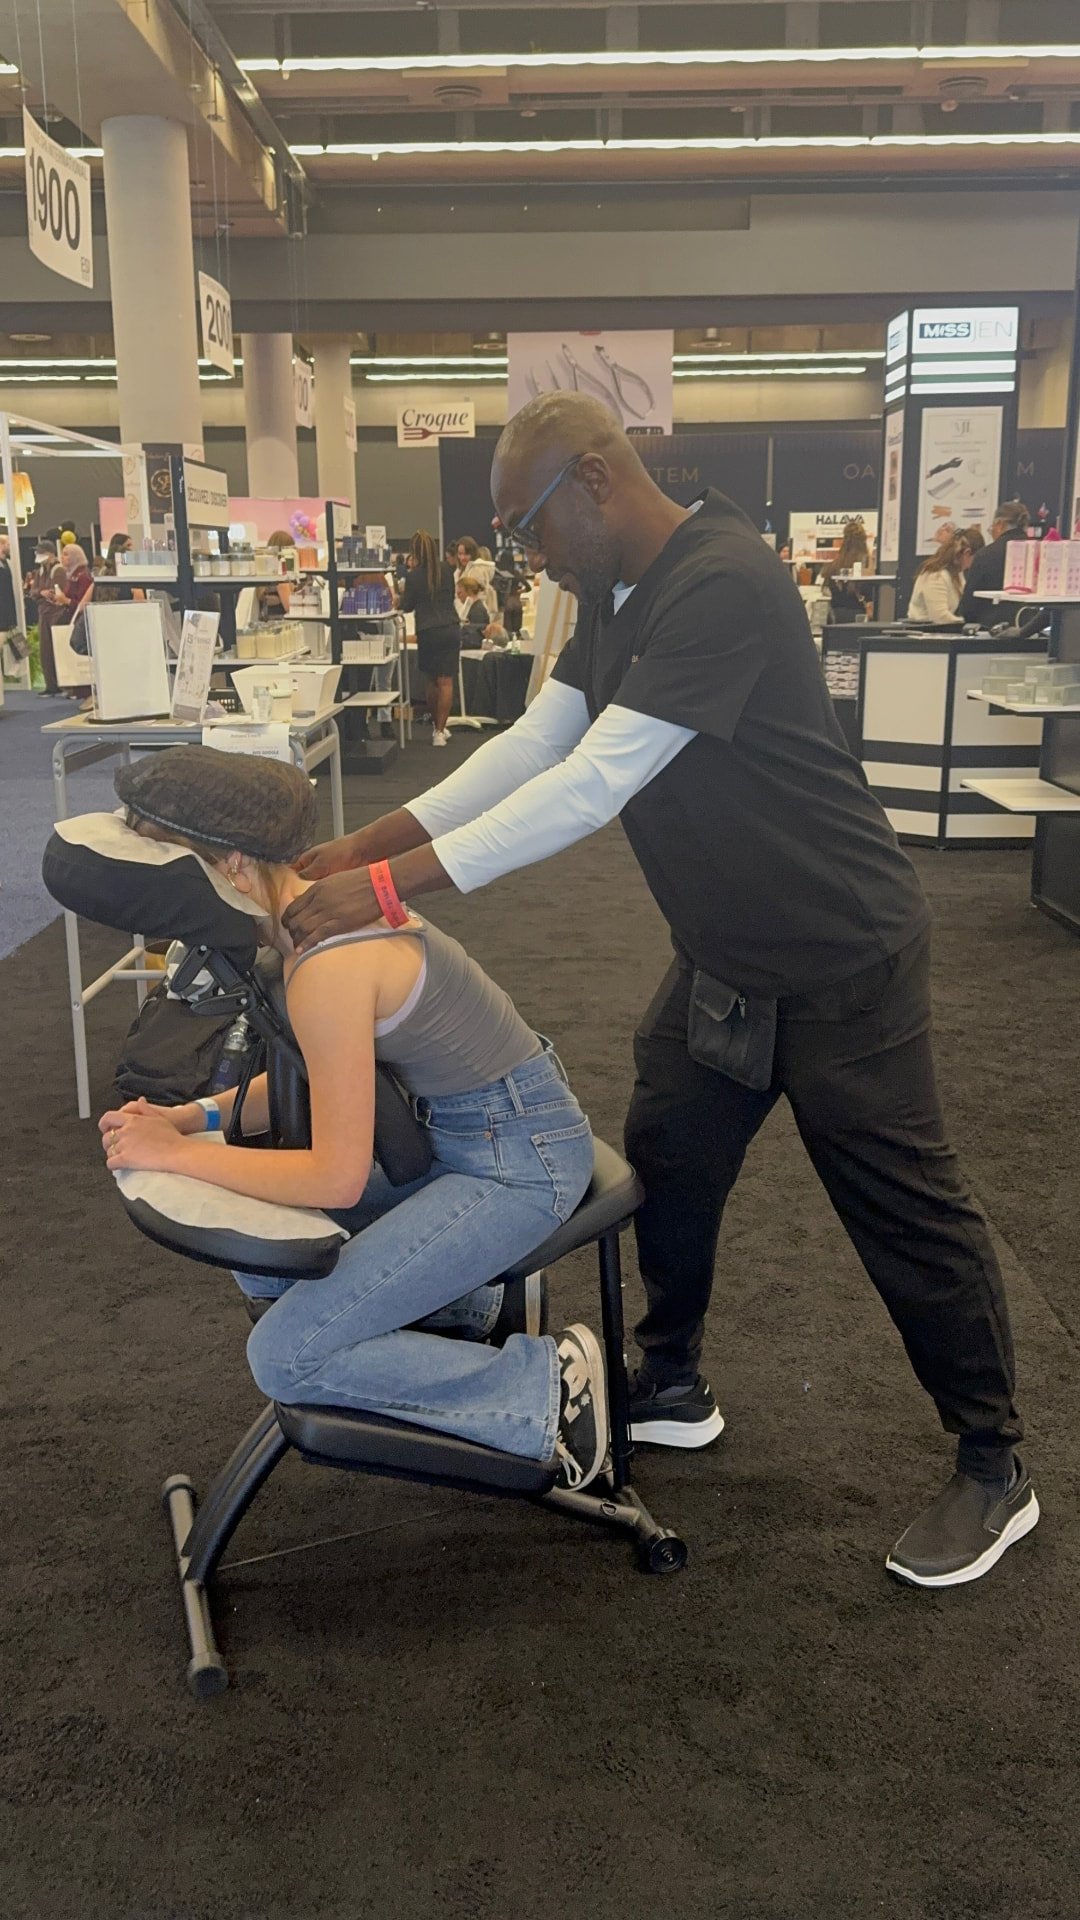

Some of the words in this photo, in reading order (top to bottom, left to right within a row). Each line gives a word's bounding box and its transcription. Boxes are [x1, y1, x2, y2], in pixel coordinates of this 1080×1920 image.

[29, 147, 80, 251] 1900
[971, 320, 1013, 342] JEN
[402, 408, 469, 432] Croque
[652, 467, 699, 483] TEM
